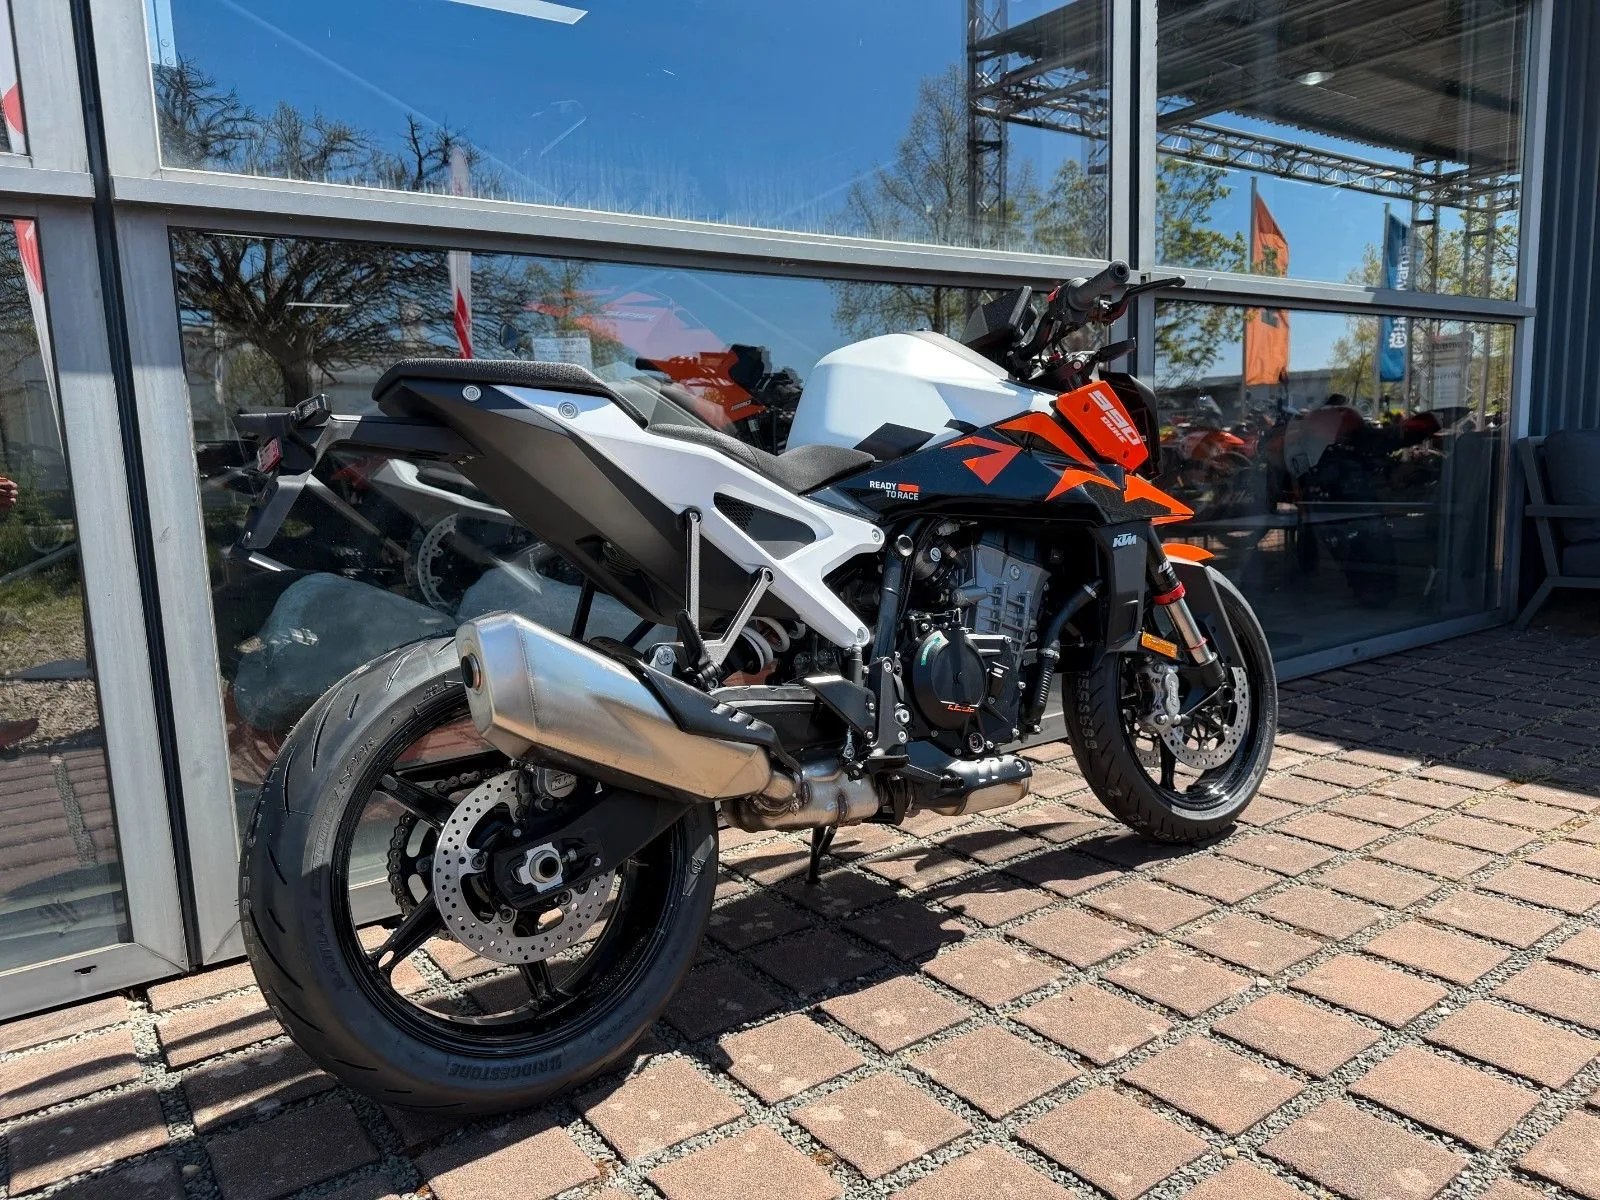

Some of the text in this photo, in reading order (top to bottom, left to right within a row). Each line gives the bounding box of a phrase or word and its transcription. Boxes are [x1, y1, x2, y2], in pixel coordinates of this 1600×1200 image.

[1088, 389, 1142, 446] 990
[1100, 415, 1128, 444] DUKE
[869, 480, 897, 491] READY
[886, 490, 919, 501] TO RACE
[1112, 532, 1137, 548] KTM
